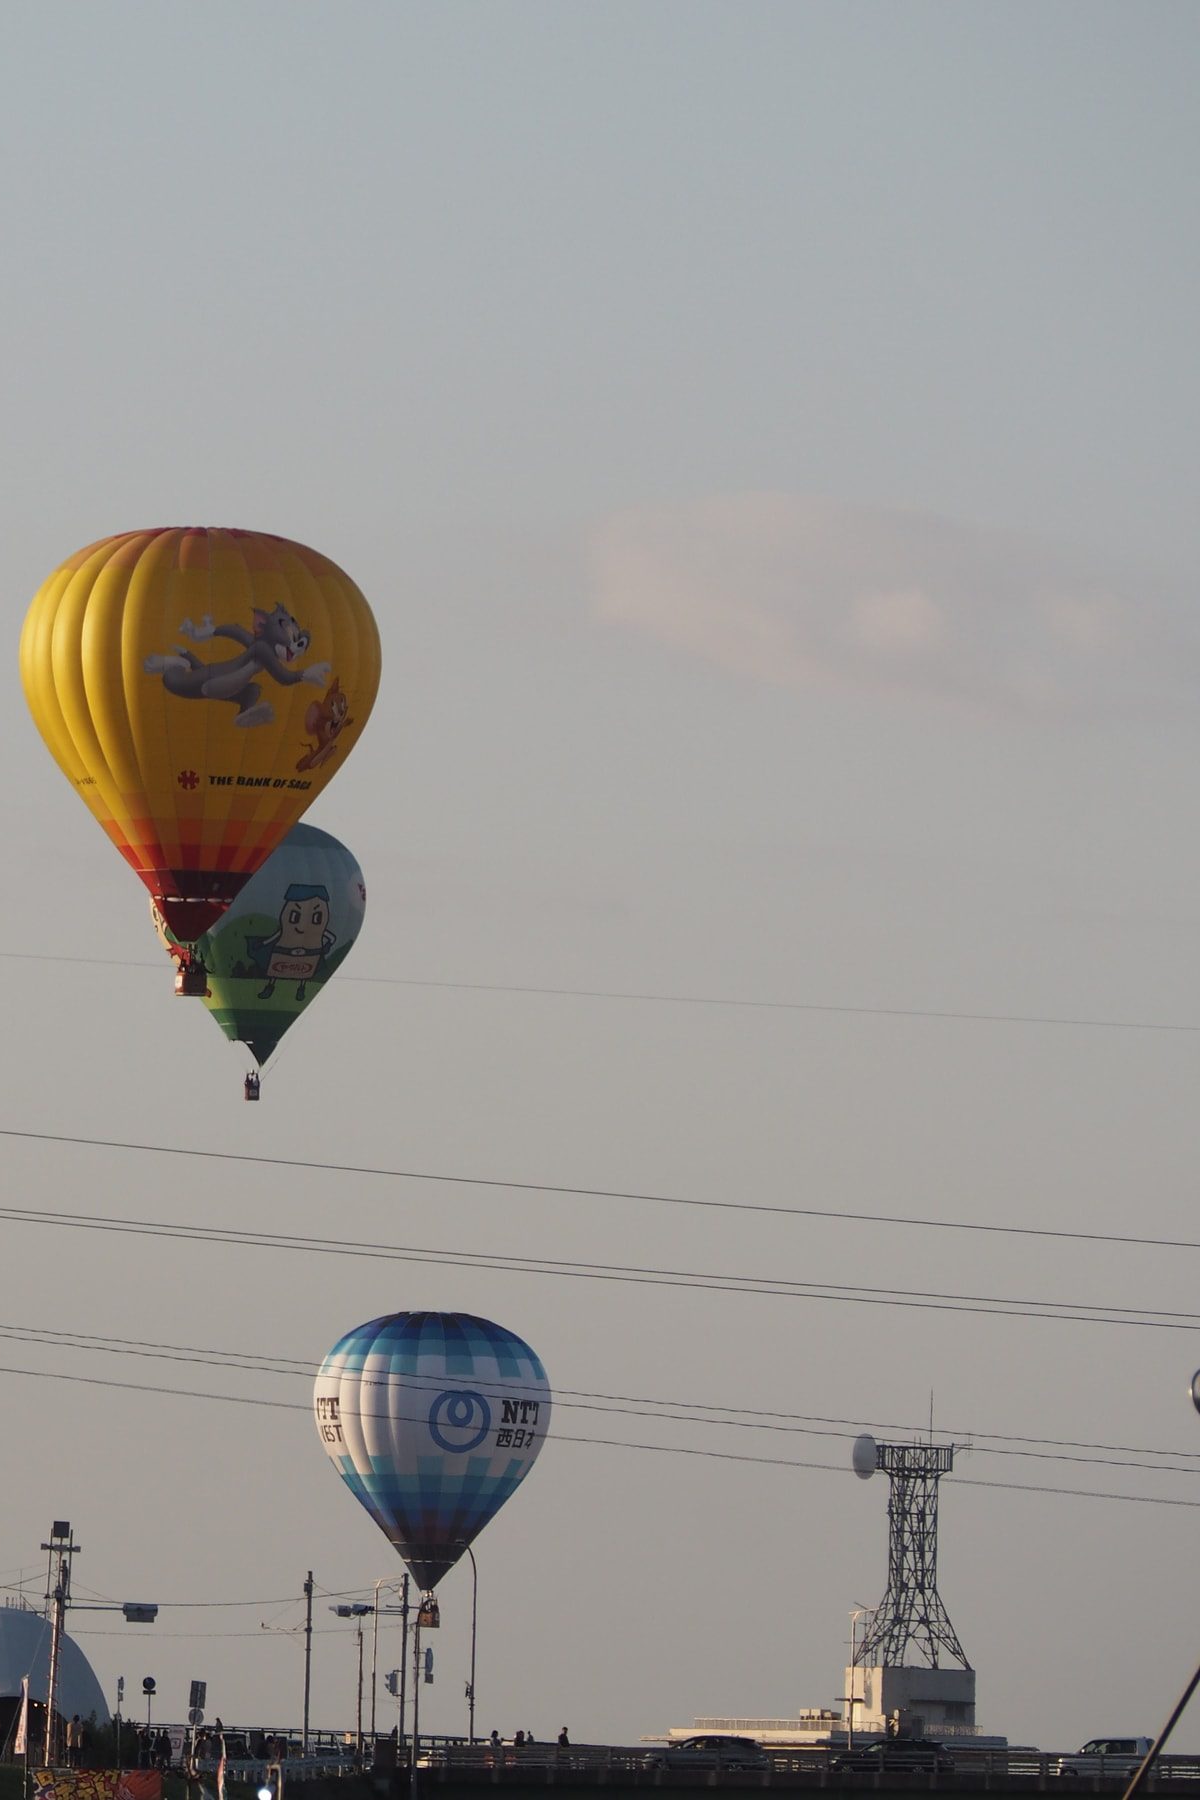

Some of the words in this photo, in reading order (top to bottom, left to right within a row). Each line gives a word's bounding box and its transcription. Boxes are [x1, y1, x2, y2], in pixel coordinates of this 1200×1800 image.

[208, 776, 234, 785] THE
[236, 776, 272, 787] BANK
[273, 778, 287, 788] OF
[317, 1397, 341, 1420] TT
[321, 1424, 342, 1444] EST
